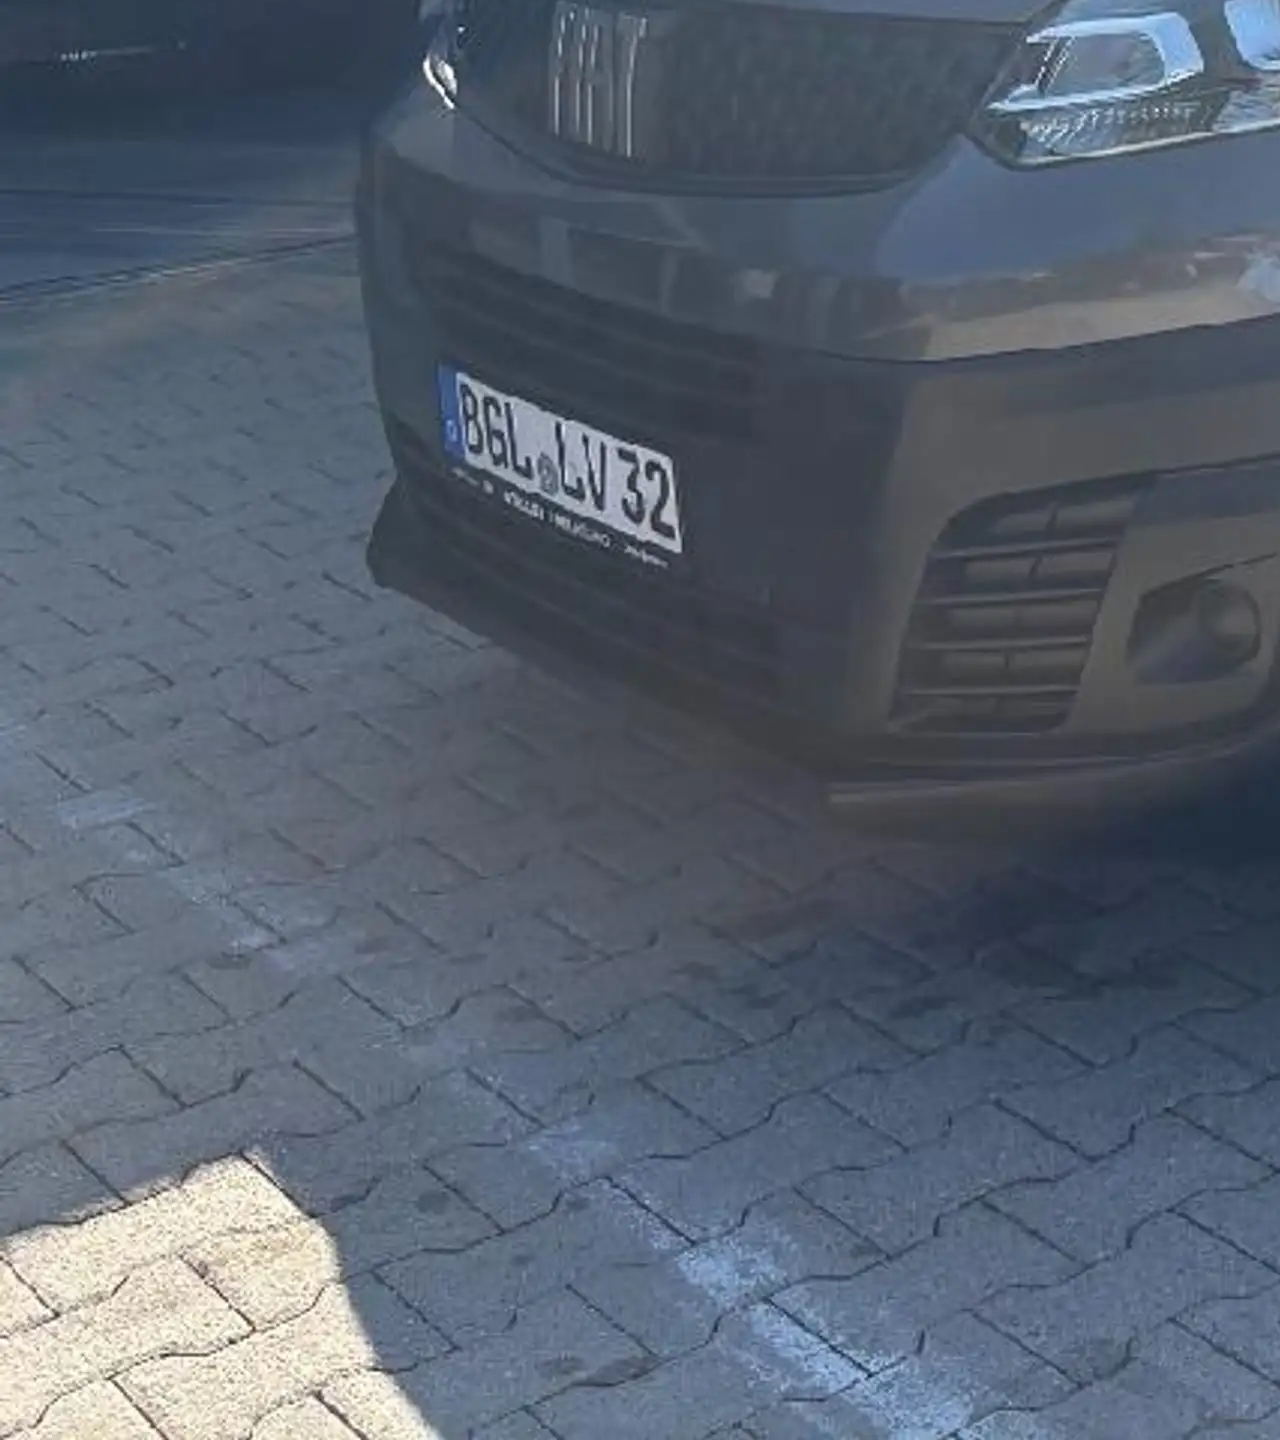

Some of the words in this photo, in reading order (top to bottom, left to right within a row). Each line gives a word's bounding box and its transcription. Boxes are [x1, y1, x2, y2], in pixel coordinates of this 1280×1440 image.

[459, 382, 533, 481] BGL
[553, 420, 608, 512] LV
[618, 447, 677, 540] 32
